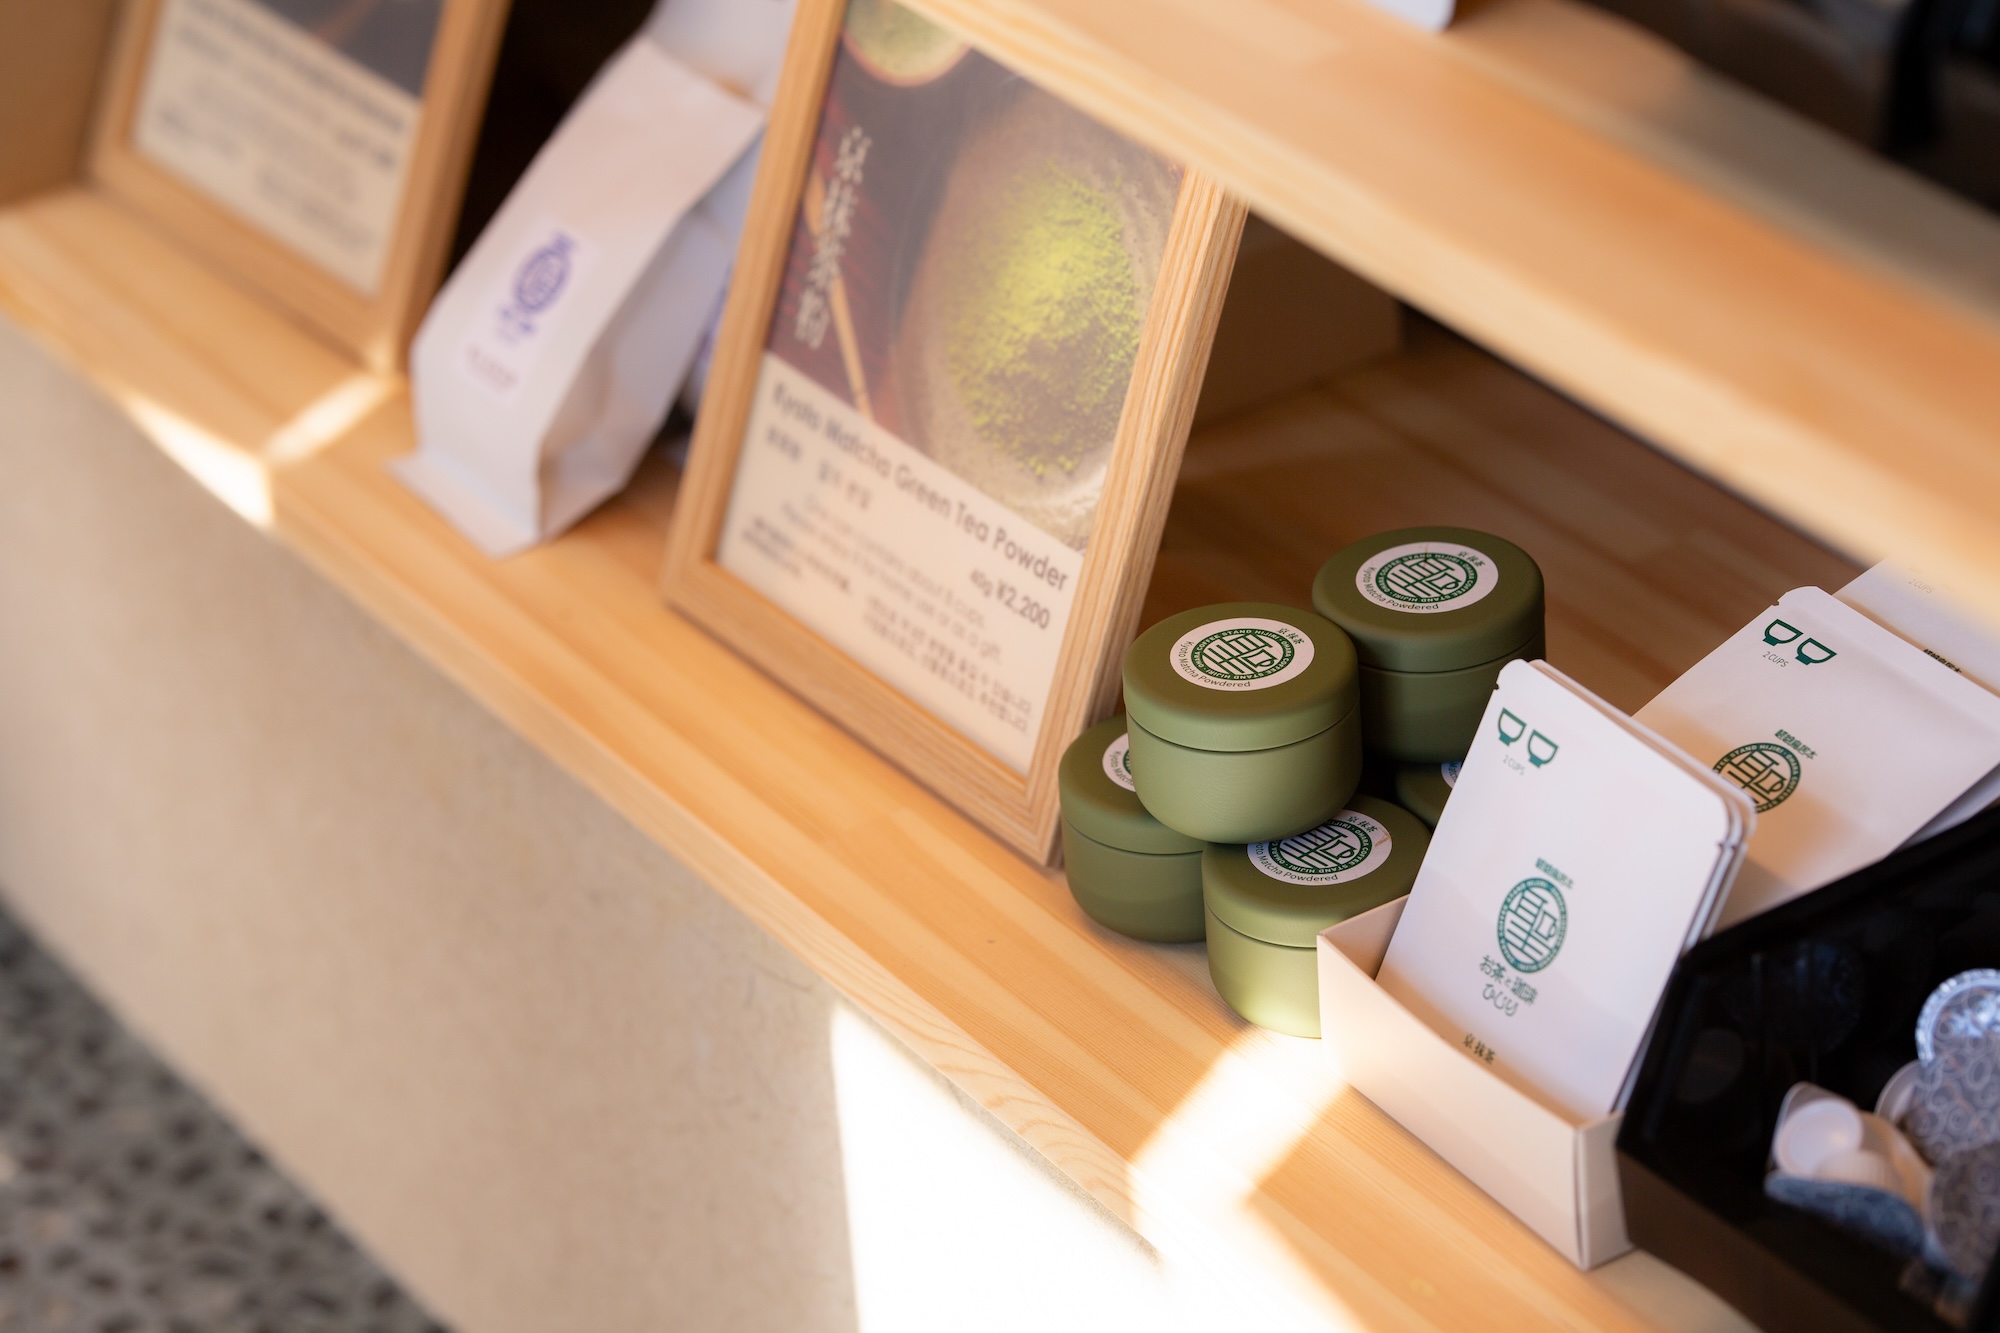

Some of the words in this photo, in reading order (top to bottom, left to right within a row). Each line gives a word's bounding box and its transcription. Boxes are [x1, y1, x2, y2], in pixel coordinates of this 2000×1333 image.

[774, 381, 821, 432] Kyoto
[825, 417, 891, 478] Matcha
[895, 464, 951, 518] Green
[955, 502, 989, 542] Tea
[993, 526, 1068, 591] Powder
[997, 578, 1050, 630] ¥2,200
[1363, 583, 1386, 602] Matcha
[1387, 600, 1439, 610] Powdered
[1178, 640, 1194, 658] Kyoto
[1197, 634, 1221, 651] COFFEE
[1222, 629, 1252, 638] STAND
[1254, 630, 1279, 640] HIJIRI
[1178, 658, 1199, 677] Matcha
[1267, 656, 1290, 674] COFFEE
[1768, 653, 1789, 667] CUPS
[1198, 674, 1251, 687] Powdered
[1206, 668, 1231, 679] HIJIRI
[1233, 671, 1264, 680] STAND
[1348, 846, 1369, 866] COFFEE
[1258, 854, 1283, 875] Matcha
[1283, 871, 1339, 882] Powdered
[1289, 864, 1315, 874] HIJIRI
[1319, 864, 1348, 874] STAND
